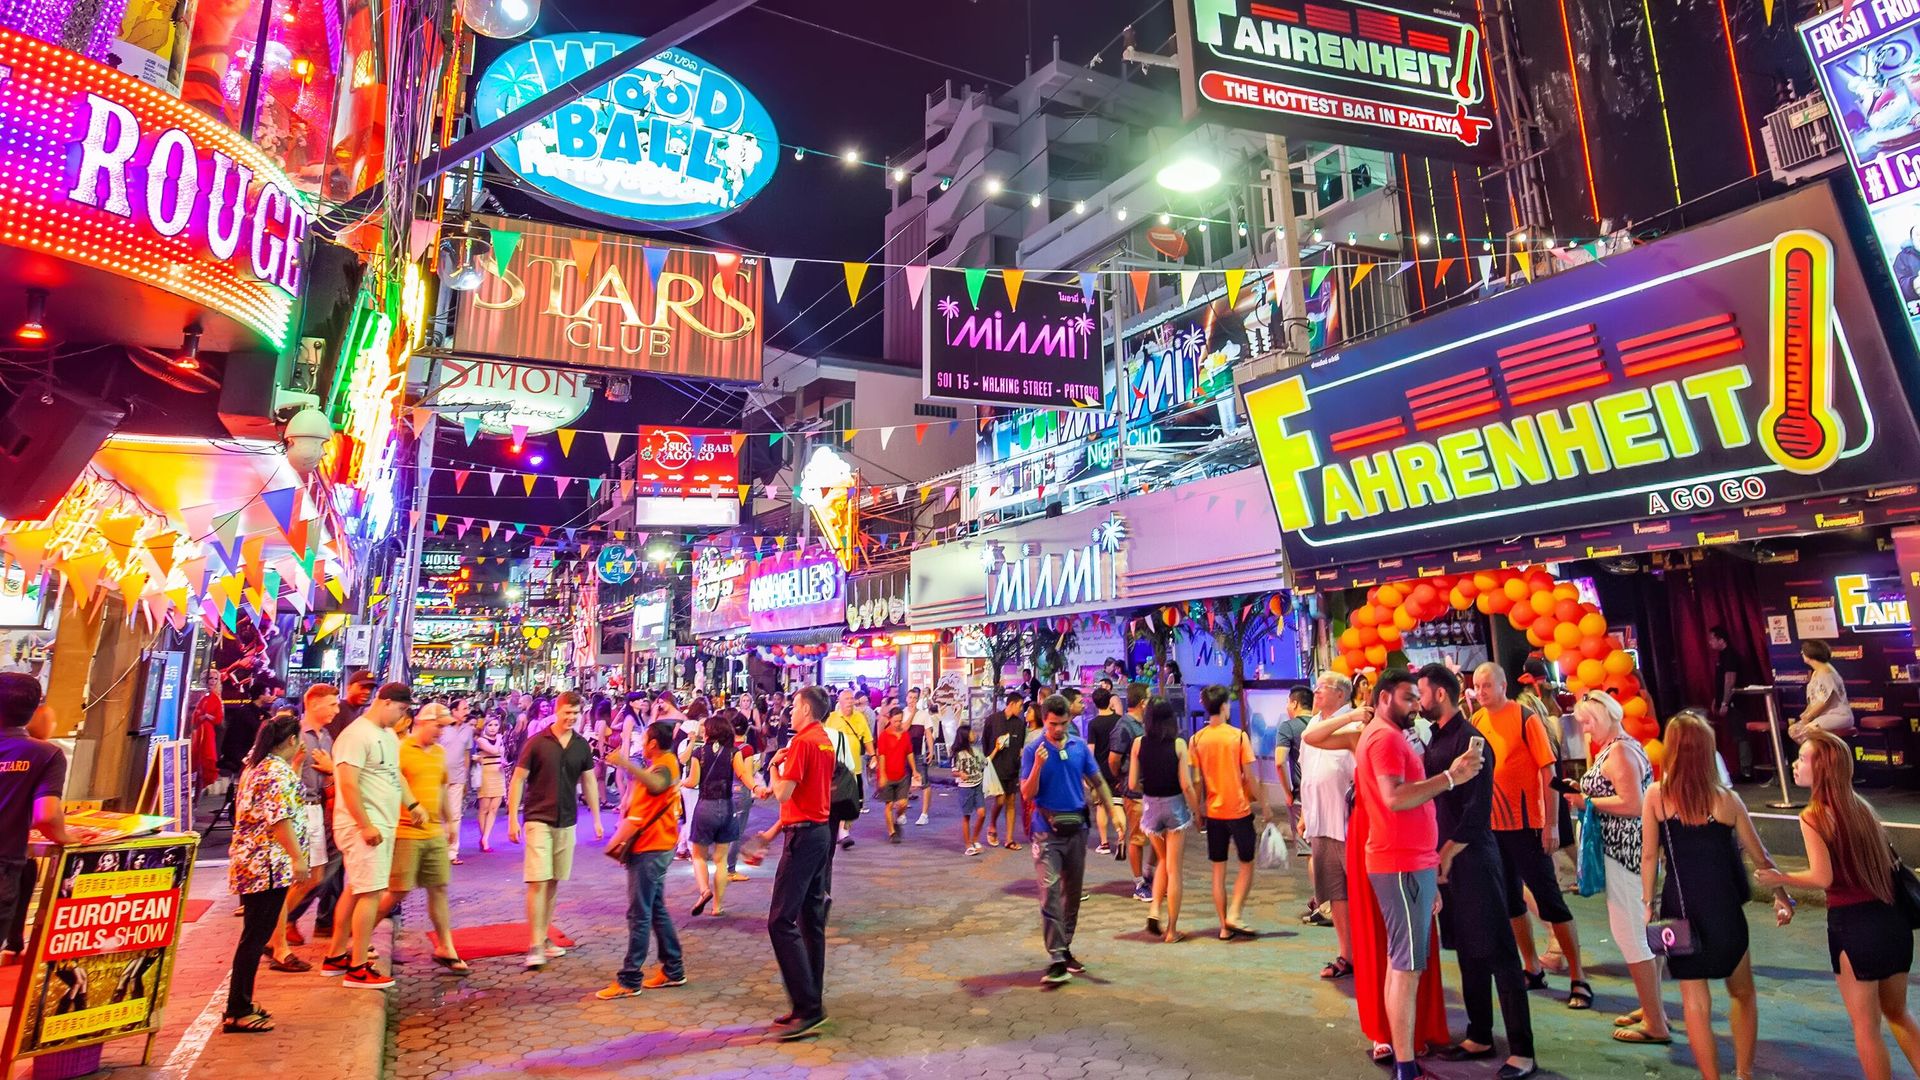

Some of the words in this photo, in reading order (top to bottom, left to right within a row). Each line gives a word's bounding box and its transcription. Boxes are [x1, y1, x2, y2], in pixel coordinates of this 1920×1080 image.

[1194, 0, 1452, 89] FAHRENHEIT
[1223, 80, 1259, 100] THE
[1263, 88, 1338, 115] HOTTEST
[1342, 102, 1375, 121] BAR
[1379, 107, 1396, 125] IN
[1399, 110, 1463, 135] PATTAYA
[553, 102, 722, 182] BALL
[68, 92, 306, 298] ROUGE
[474, 237, 757, 341] STARS
[565, 320, 673, 358] CLUB
[440, 358, 578, 398] SIMON
[937, 371, 952, 388] SOI
[956, 373, 970, 390] 15
[982, 375, 1020, 395] WALKING
[1022, 380, 1053, 397] STREET
[1064, 383, 1099, 401] PATTAYA
[668, 442, 735, 453] SUGRBABY
[1126, 424, 1162, 449] Club
[1243, 363, 1753, 532] FAHRENHEIT
[1648, 492, 1671, 515] A
[1670, 484, 1715, 511] GO
[1719, 477, 1767, 503] GO
[54, 896, 173, 931] EUROPEAN
[49, 928, 108, 956] GIRLS
[112, 922, 169, 948] SHOW
